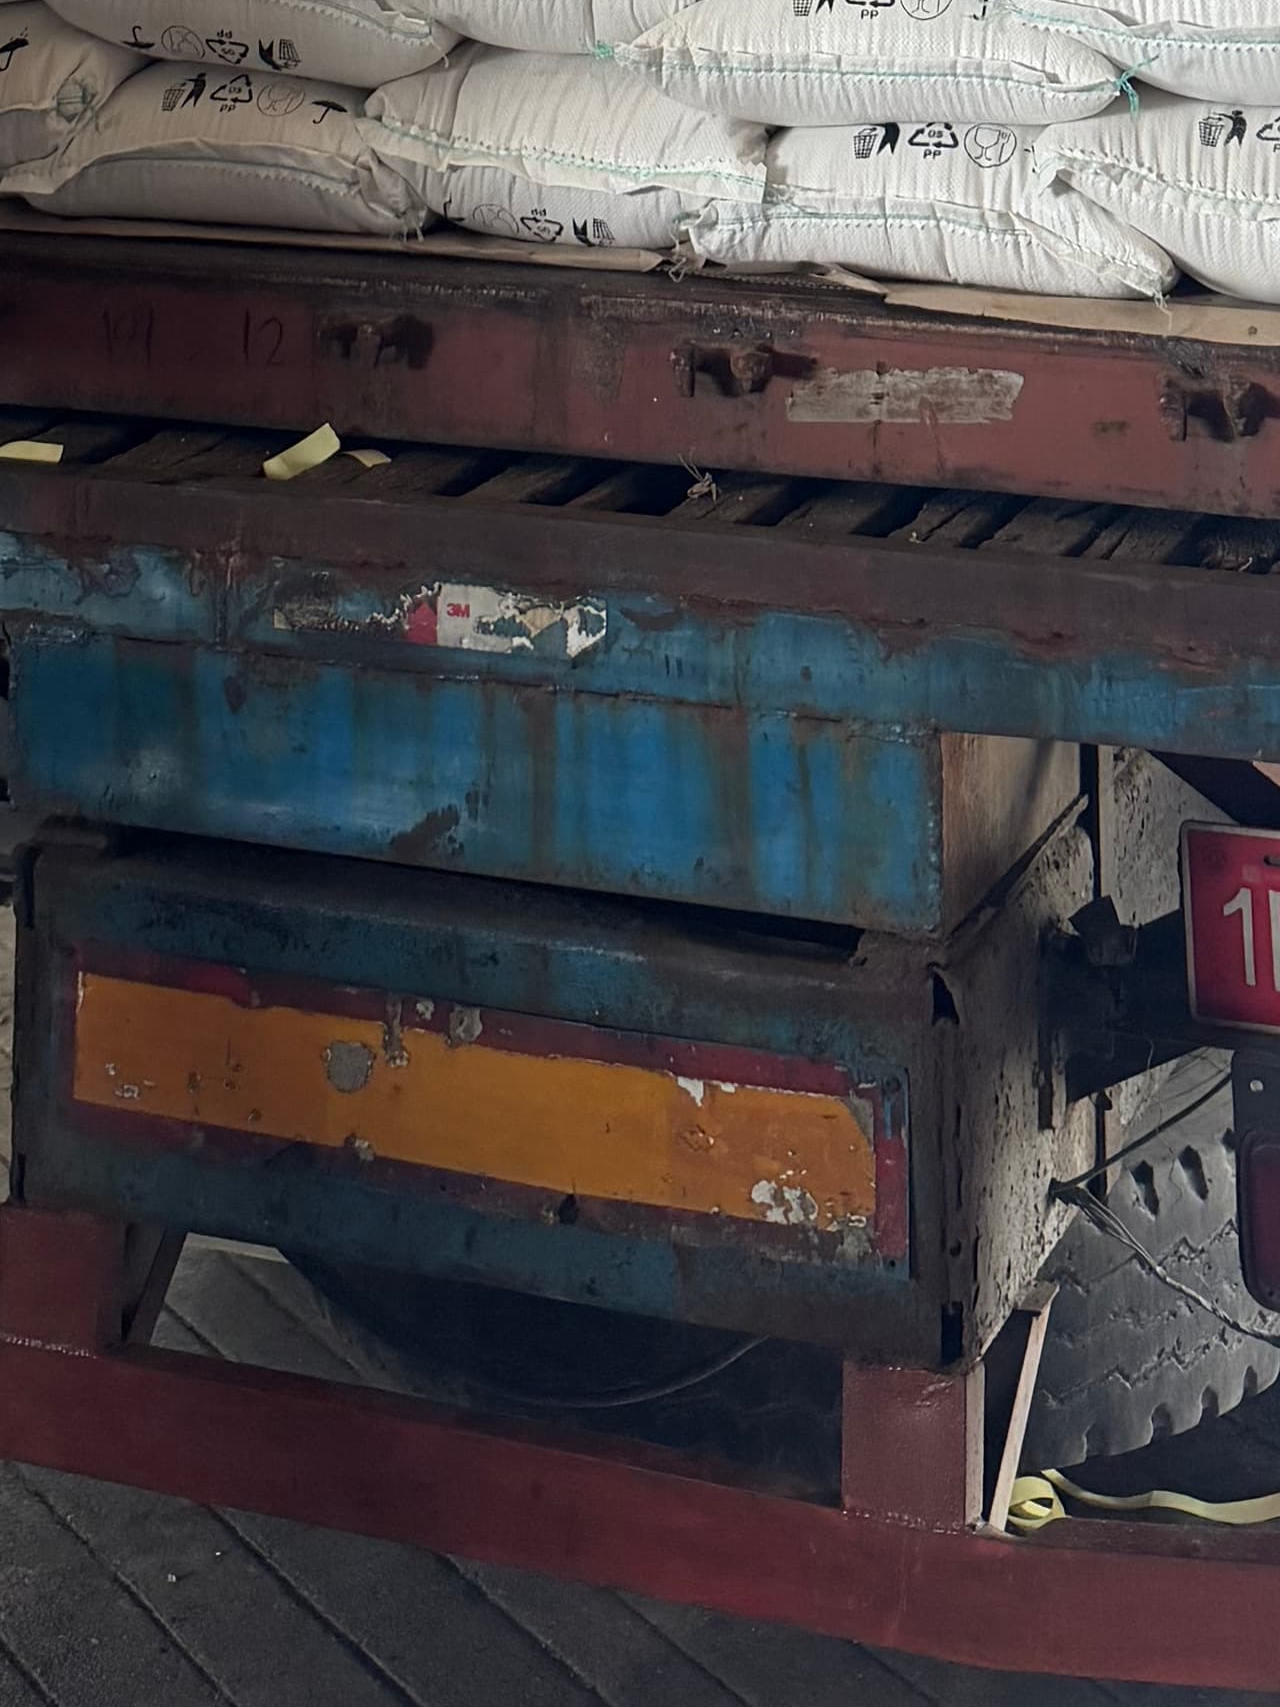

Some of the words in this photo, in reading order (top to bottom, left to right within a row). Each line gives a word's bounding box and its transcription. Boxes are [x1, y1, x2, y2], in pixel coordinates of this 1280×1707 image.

[861, 8, 879, 20] PP
[217, 30, 232, 39] PP
[219, 104, 236, 112] PP
[928, 129, 944, 138] 05
[446, 602, 471, 619] 3M
